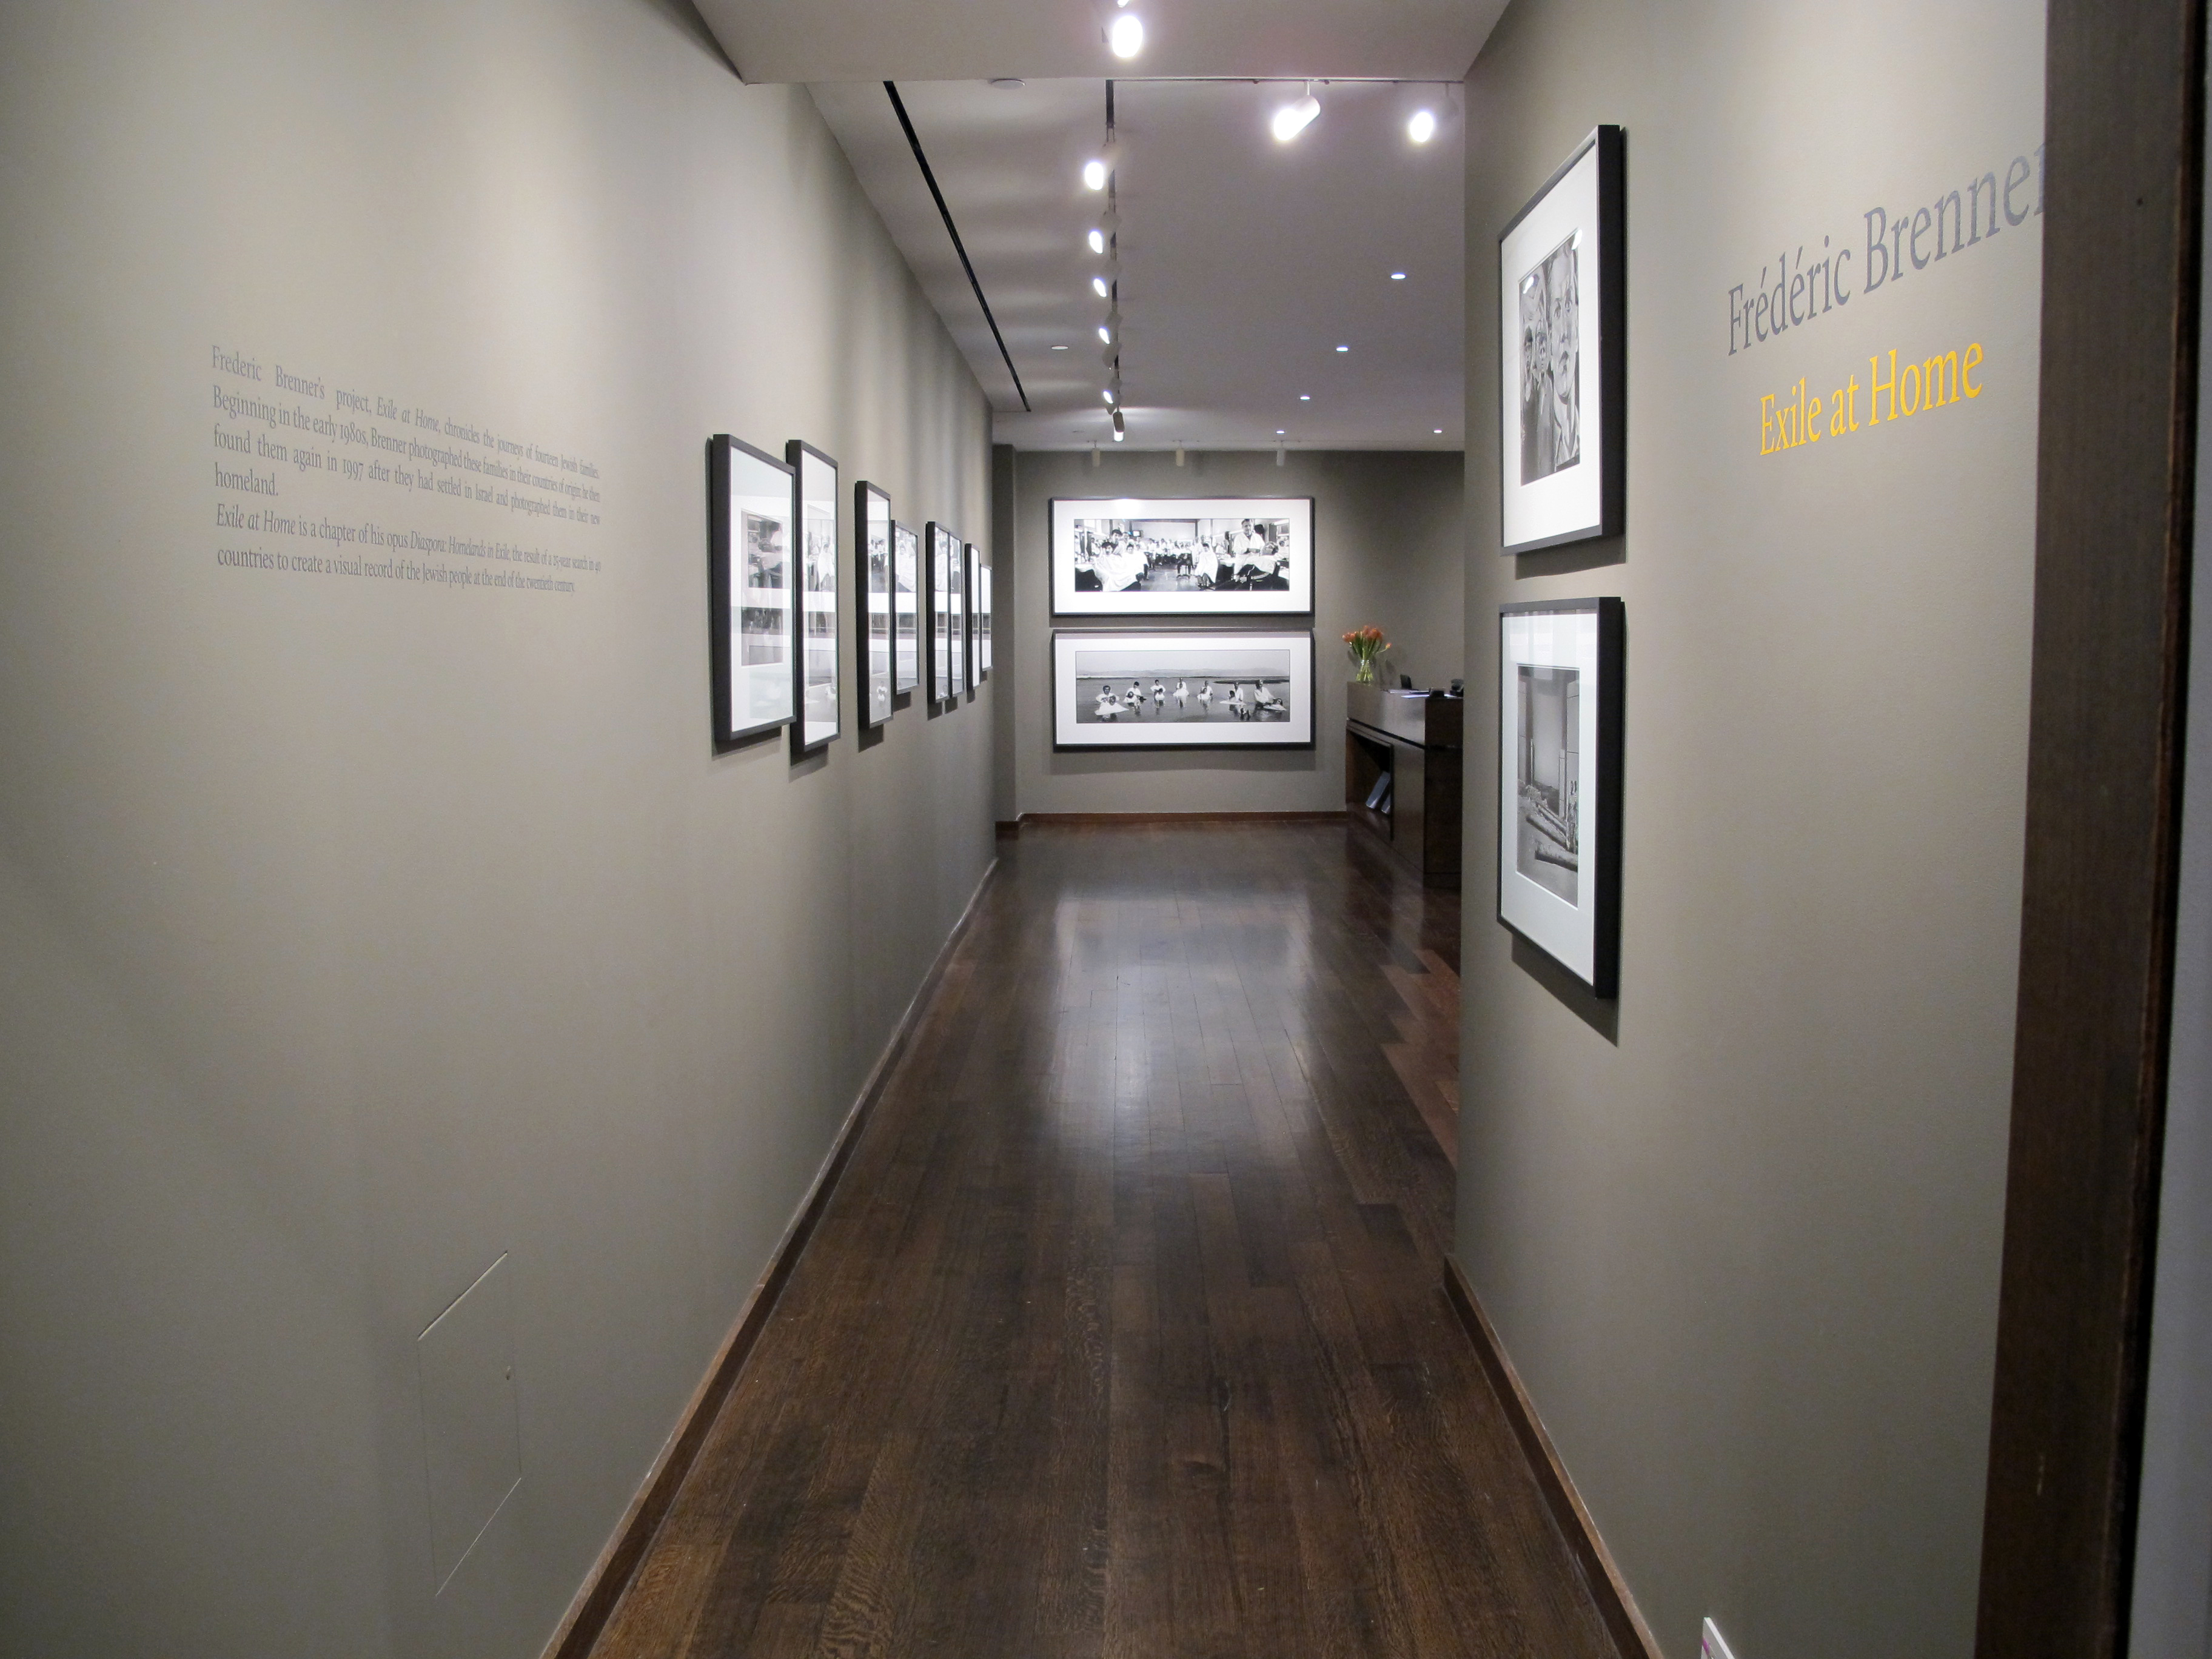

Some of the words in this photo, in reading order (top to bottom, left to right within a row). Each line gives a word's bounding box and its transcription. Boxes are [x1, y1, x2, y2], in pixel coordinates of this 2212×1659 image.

[1728, 235, 1851, 356] Frédéric
[212, 344, 261, 381] Frederic
[276, 364, 325, 399] Brenner's
[336, 389, 372, 414] project,
[377, 397, 397, 420] Exile
[401, 409, 411, 424] at
[415, 408, 440, 434] Home,
[444, 417, 480, 443] chronicles
[484, 429, 494, 448] the
[498, 434, 523, 460] journeys
[526, 443, 533, 460] of
[213, 384, 276, 429] Beginning
[279, 403, 290, 426] in
[293, 406, 310, 431] the
[313, 415, 337, 443] early
[341, 422, 369, 449] 1980s,
[371, 427, 407, 454] Brenner
[409, 437, 462, 469] photographed
[464, 452, 481, 472] these
[483, 457, 509, 479] families
[509, 464, 515, 481] in
[1760, 377, 1822, 455] Exile
[1830, 374, 1860, 437] at
[1868, 342, 1984, 426] Home
[214, 423, 250, 454] found
[258, 434, 287, 461] them
[293, 446, 322, 472] again
[327, 450, 338, 471] in
[343, 458, 364, 481] 1997
[369, 460, 390, 482] after
[395, 465, 414, 492] they
[418, 469, 433, 491] had
[437, 477, 461, 496] settled
[465, 481, 472, 498] in
[475, 484, 493, 503] Israel
[496, 489, 508, 506] and
[511, 492, 551, 517] photographed
[215, 462, 278, 496] homeland.
[217, 503, 244, 529] Exile
[248, 512, 260, 531] at
[264, 510, 296, 535] Home
[299, 515, 308, 537] is
[311, 523, 317, 538] a
[320, 517, 355, 546] chapter
[358, 523, 369, 543] of
[371, 524, 384, 545] his
[387, 532, 408, 552] opus
[411, 531, 446, 556] Diaspora:
[449, 536, 486, 557] Homelands
[488, 542, 494, 558] in
[512, 545, 522, 561] the
[218, 547, 273, 569] countries
[278, 553, 289, 571] to
[292, 555, 323, 573] create
[326, 559, 332, 573] a
[333, 555, 363, 576] visual
[364, 558, 393, 578] record
[395, 560, 406, 579] of
[407, 561, 420, 580] the
[423, 563, 447, 584] Jewish
[449, 566, 472, 589] people
[474, 572, 481, 585] at
[482, 569, 493, 586] the
[494, 571, 506, 587] end
[508, 571, 515, 588] of
[515, 572, 525, 588] the
